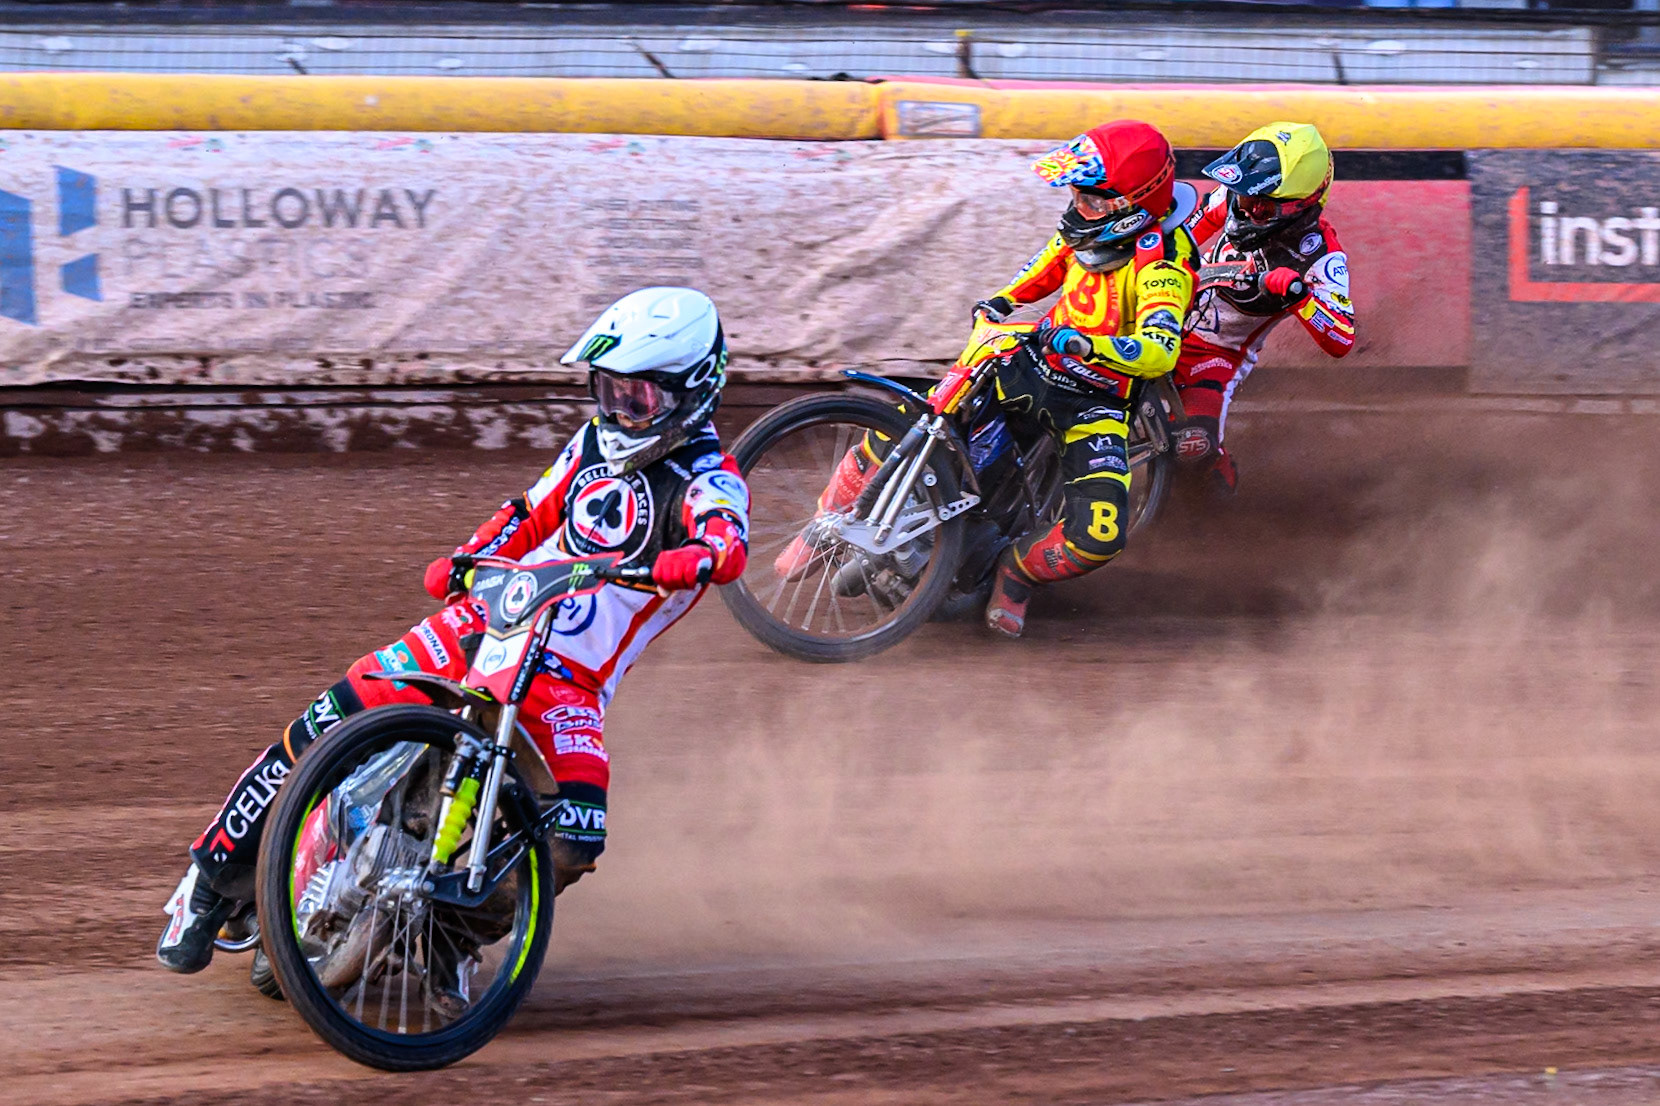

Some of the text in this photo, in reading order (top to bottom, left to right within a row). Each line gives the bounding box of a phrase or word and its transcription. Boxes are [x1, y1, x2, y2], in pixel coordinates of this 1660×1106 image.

[120, 187, 437, 229] HOLLOWAY
[1540, 201, 1660, 266] inst
[1178, 439, 1206, 453] STS
[636, 492, 648, 526] ACES
[1087, 501, 1119, 542] B
[559, 804, 606, 830] DVR
